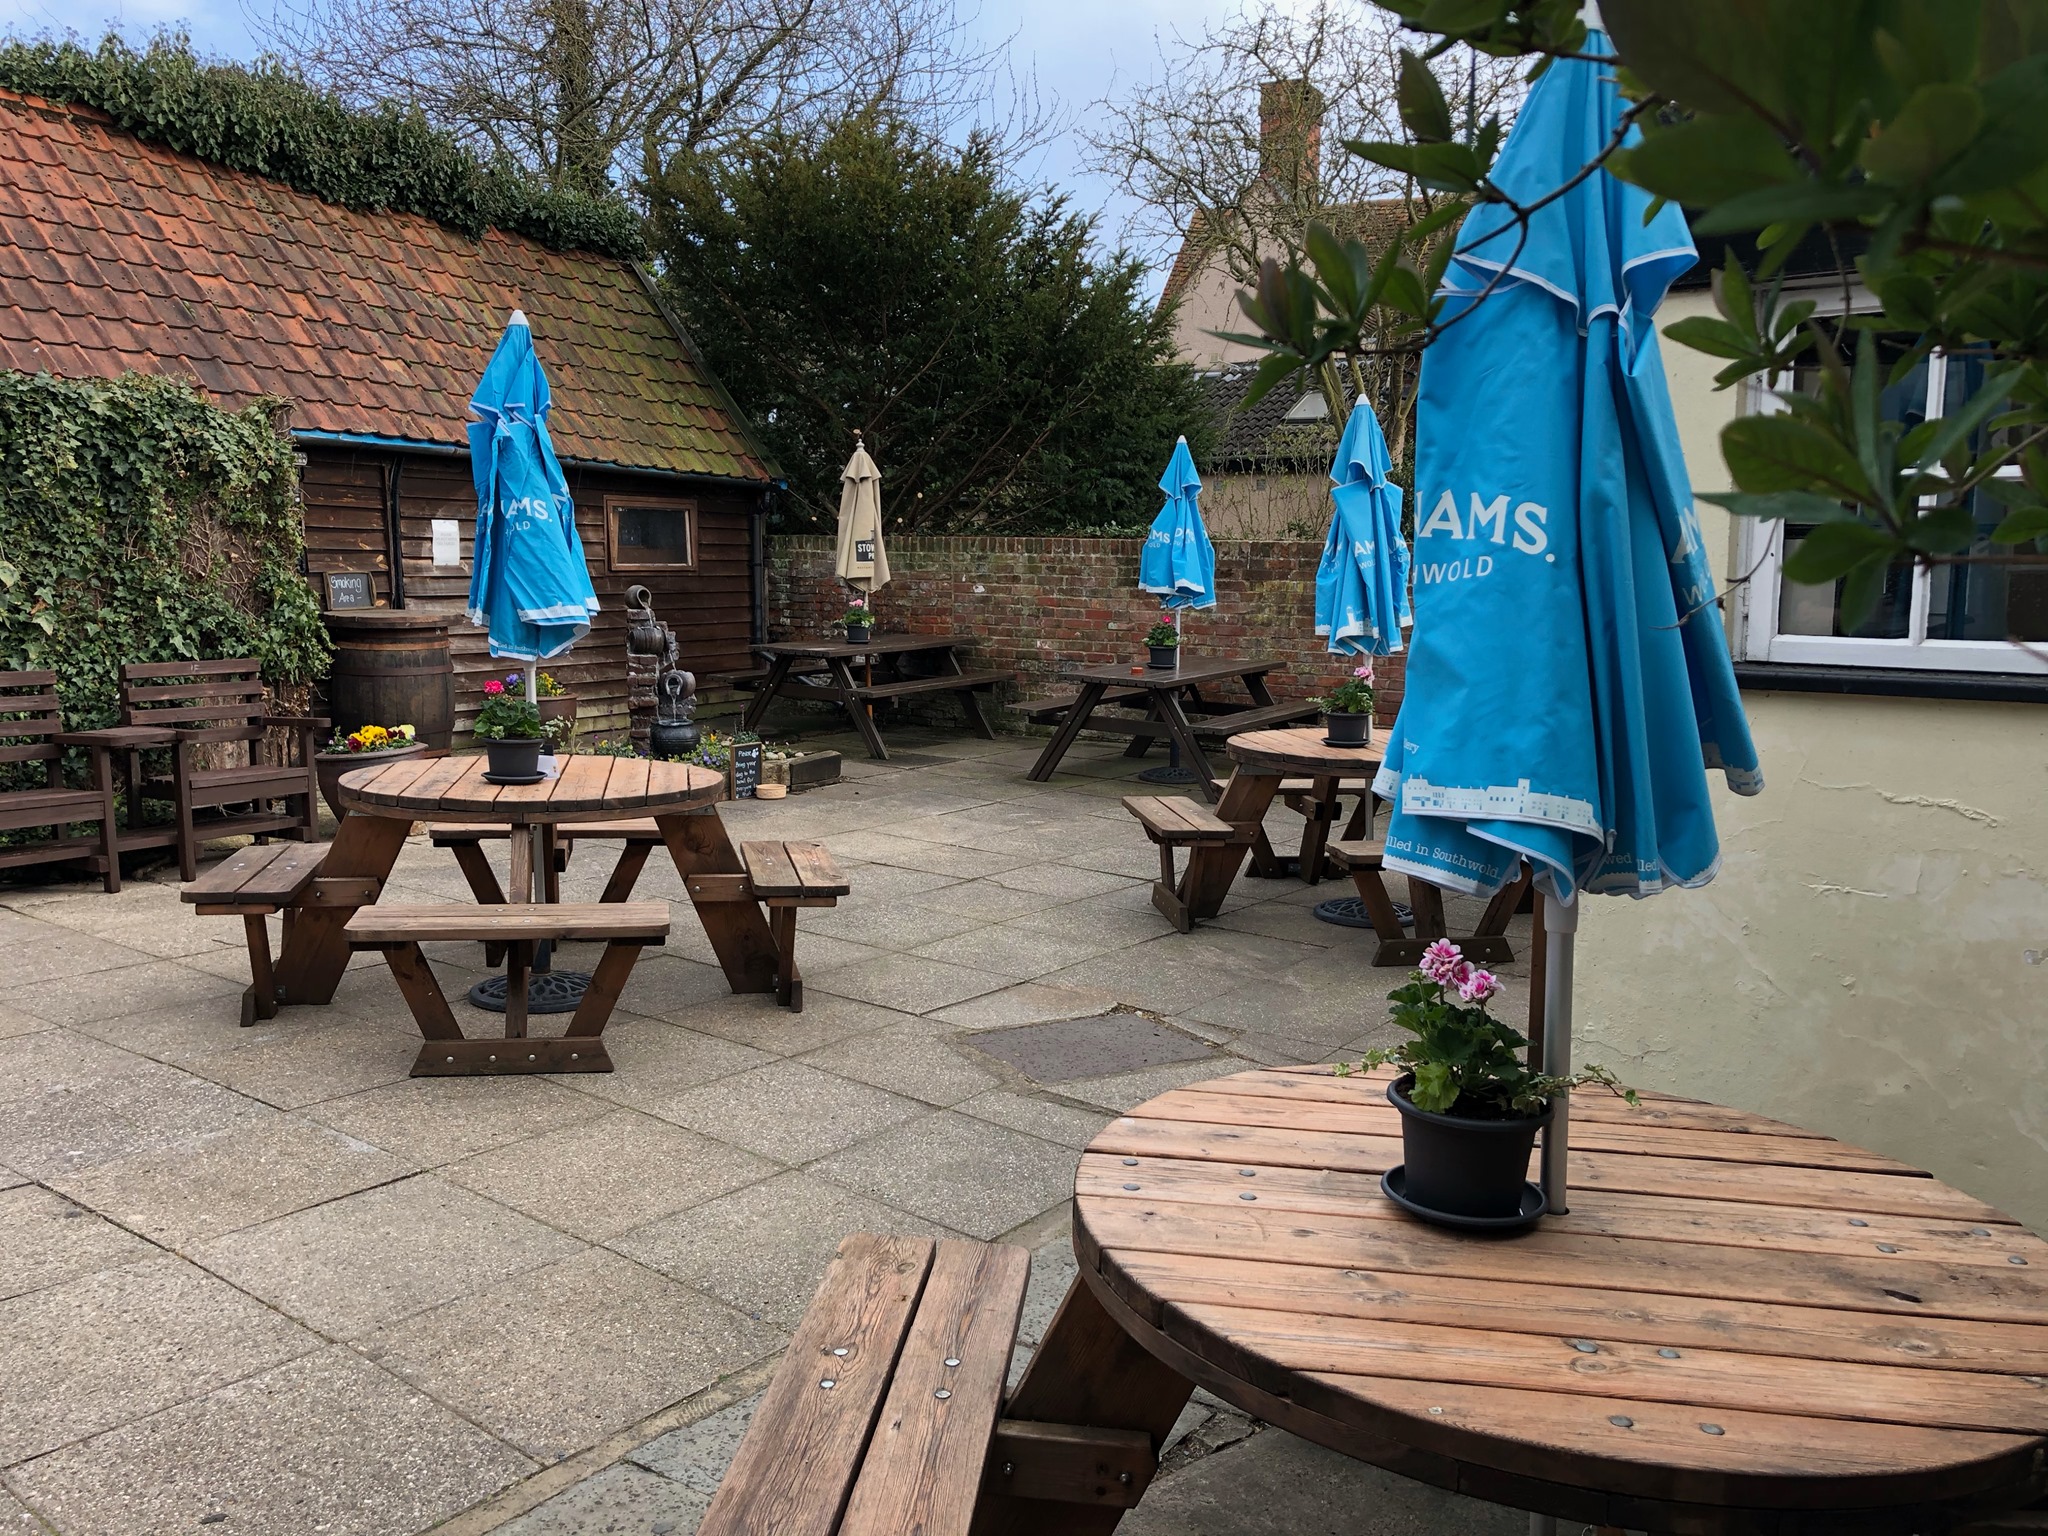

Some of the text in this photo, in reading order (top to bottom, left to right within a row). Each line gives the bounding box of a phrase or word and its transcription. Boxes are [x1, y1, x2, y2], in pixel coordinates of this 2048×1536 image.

[501, 496, 553, 523] AMS.
[330, 576, 362, 593] Smoking
[338, 592, 355, 603] Area
[1415, 843, 1429, 857] in
